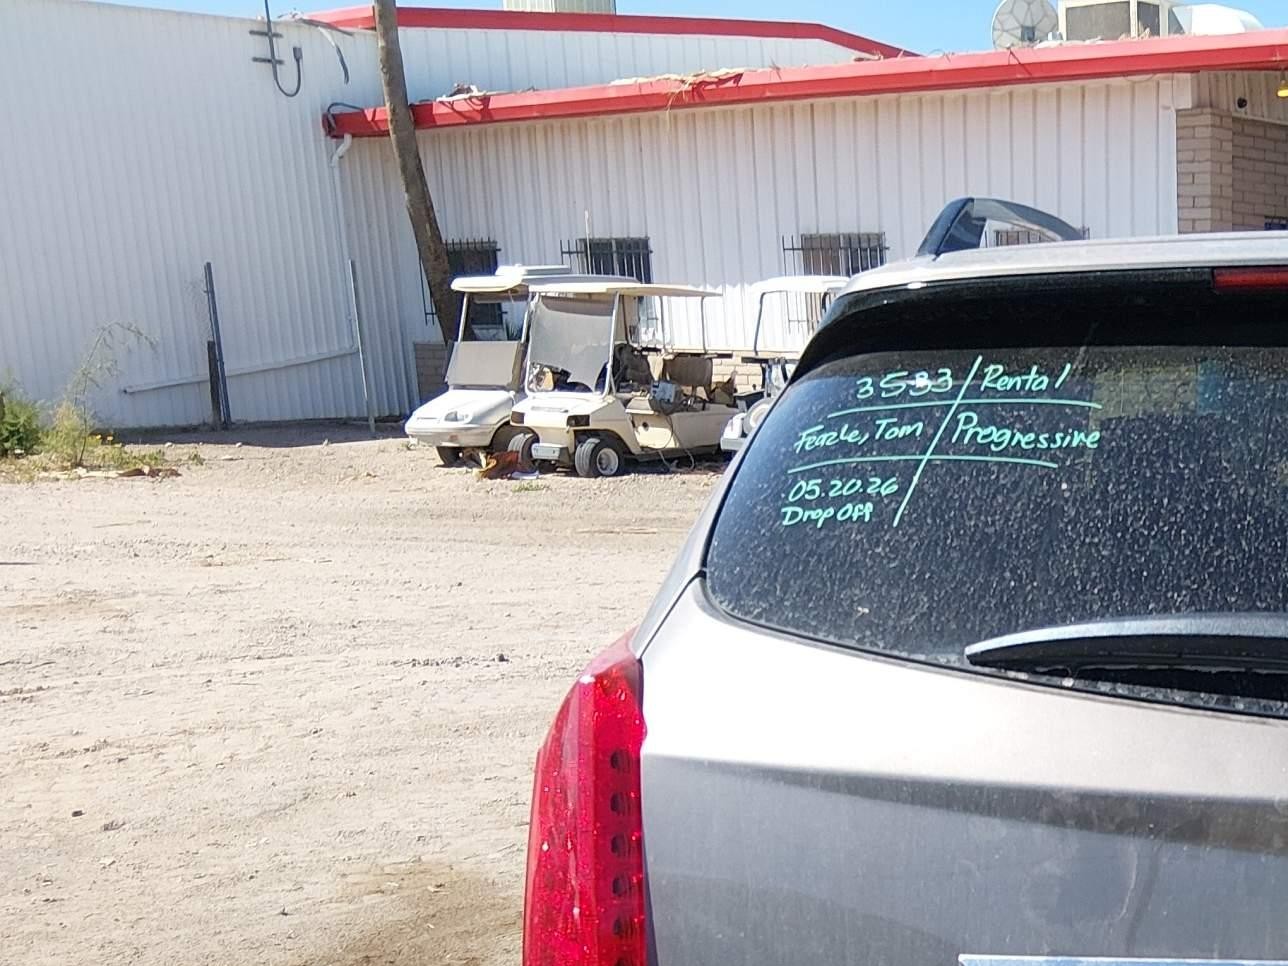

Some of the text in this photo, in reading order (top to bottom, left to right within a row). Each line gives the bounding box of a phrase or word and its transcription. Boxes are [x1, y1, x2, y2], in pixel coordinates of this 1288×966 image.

[980, 362, 1071, 392] Rental
[875, 417, 924, 440] Tom
[951, 411, 1101, 451] Progressive
[788, 477, 899, 502] 05.20.26
[781, 502, 873, 529] Drop Off
